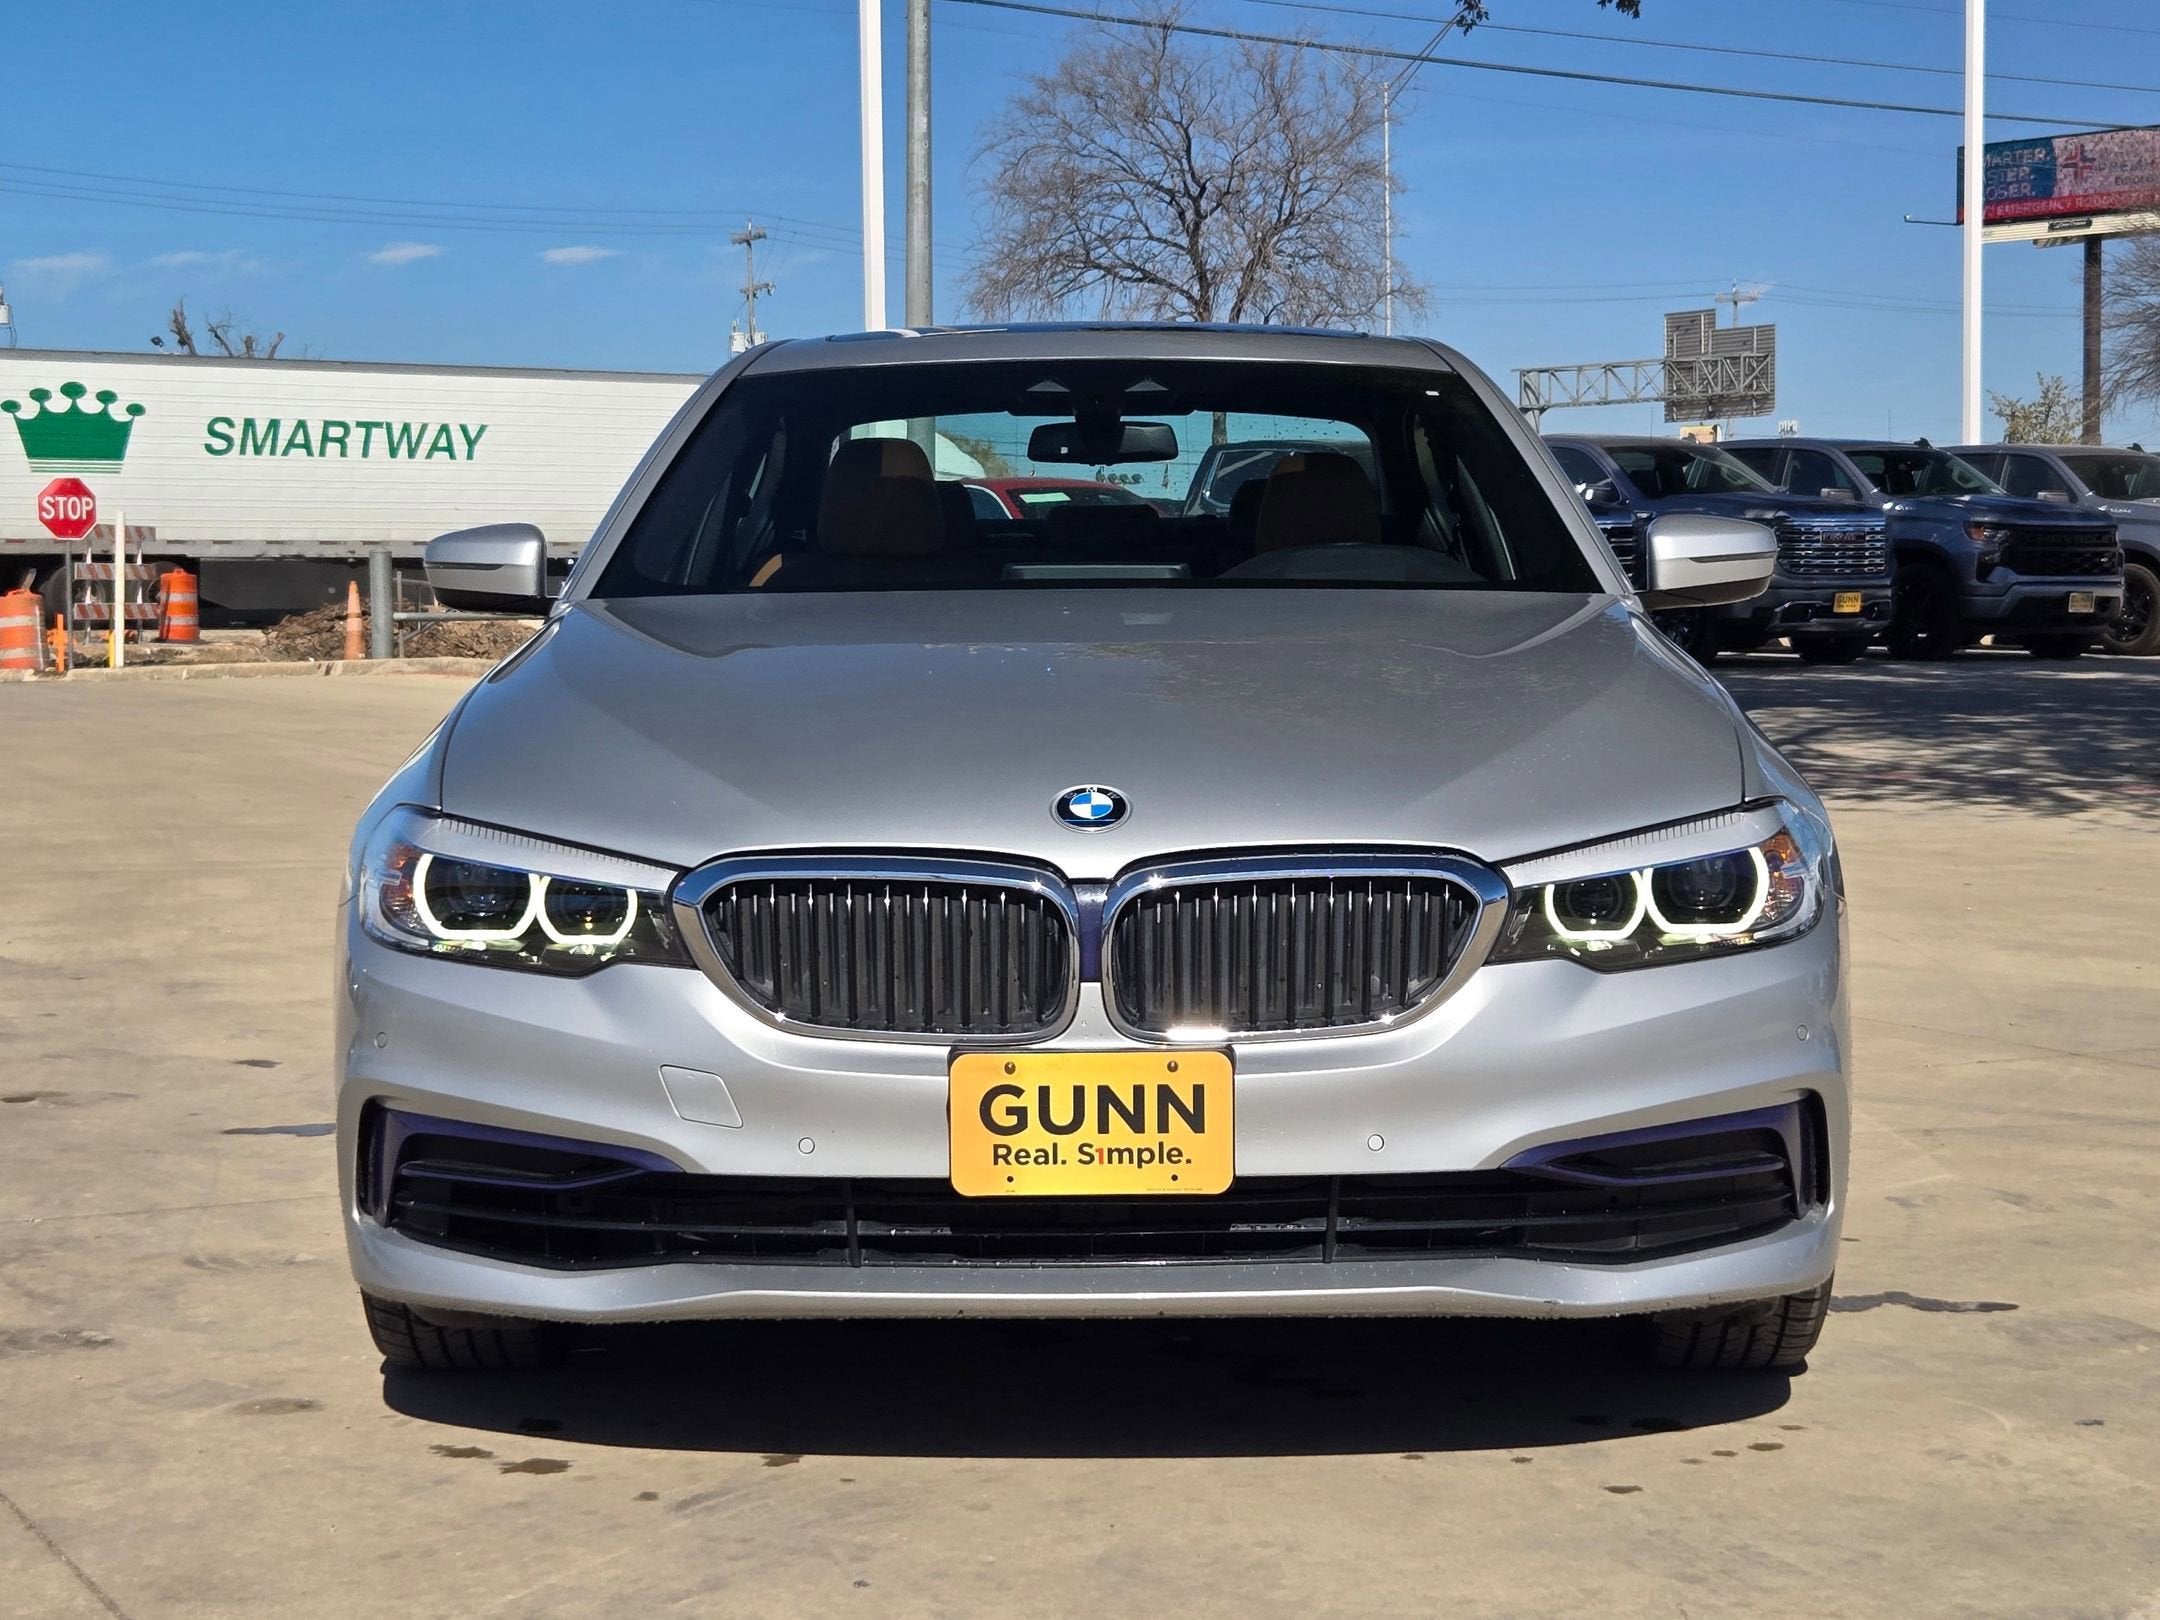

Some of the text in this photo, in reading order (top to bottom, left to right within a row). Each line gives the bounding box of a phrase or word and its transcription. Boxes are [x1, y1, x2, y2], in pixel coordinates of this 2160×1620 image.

[204, 416, 489, 461] SMARTWAY
[41, 496, 94, 521] STOP
[979, 1083, 1205, 1136] GUNN
[992, 1142, 1067, 1166] Real.
